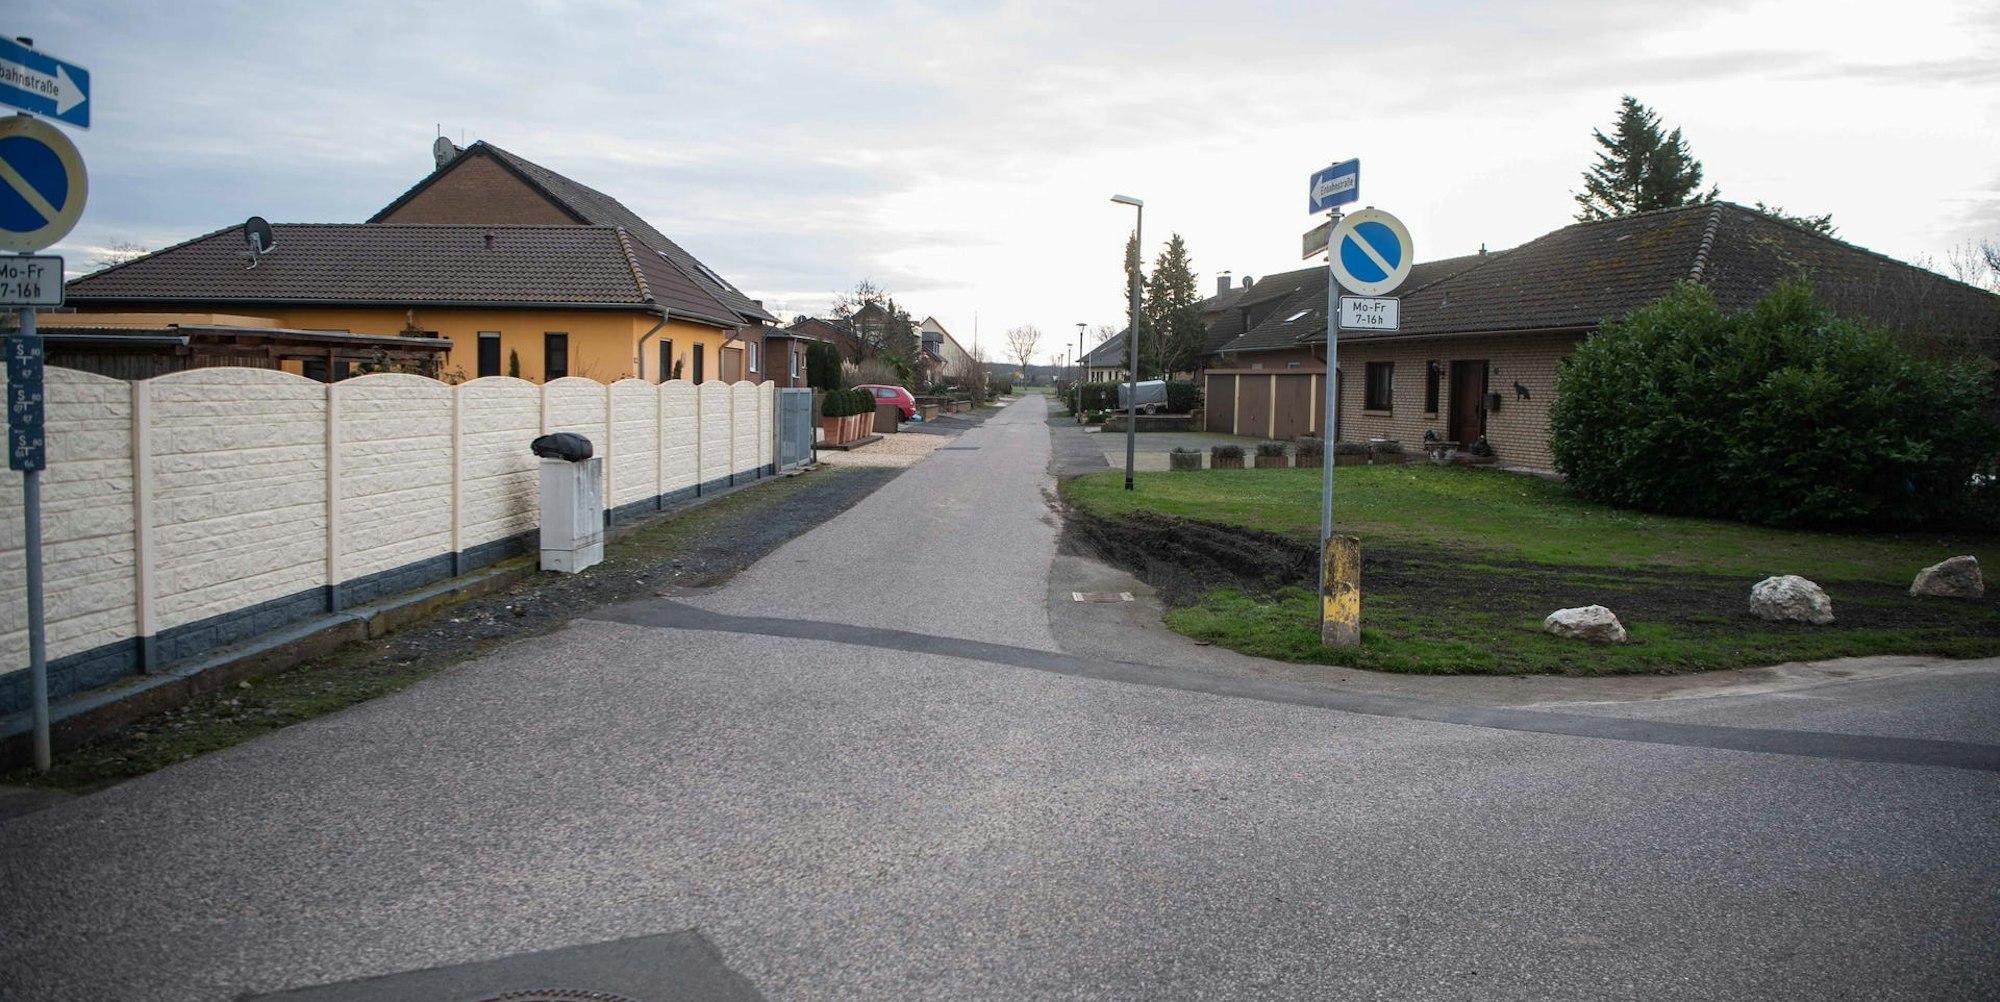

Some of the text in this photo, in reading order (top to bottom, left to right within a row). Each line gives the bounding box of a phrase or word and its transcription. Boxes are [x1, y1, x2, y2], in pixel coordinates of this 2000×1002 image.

[1353, 301, 1386, 312] Mo-Fr
[16, 343, 24, 355] S
[17, 389, 25, 401] S
[18, 435, 26, 446] S
